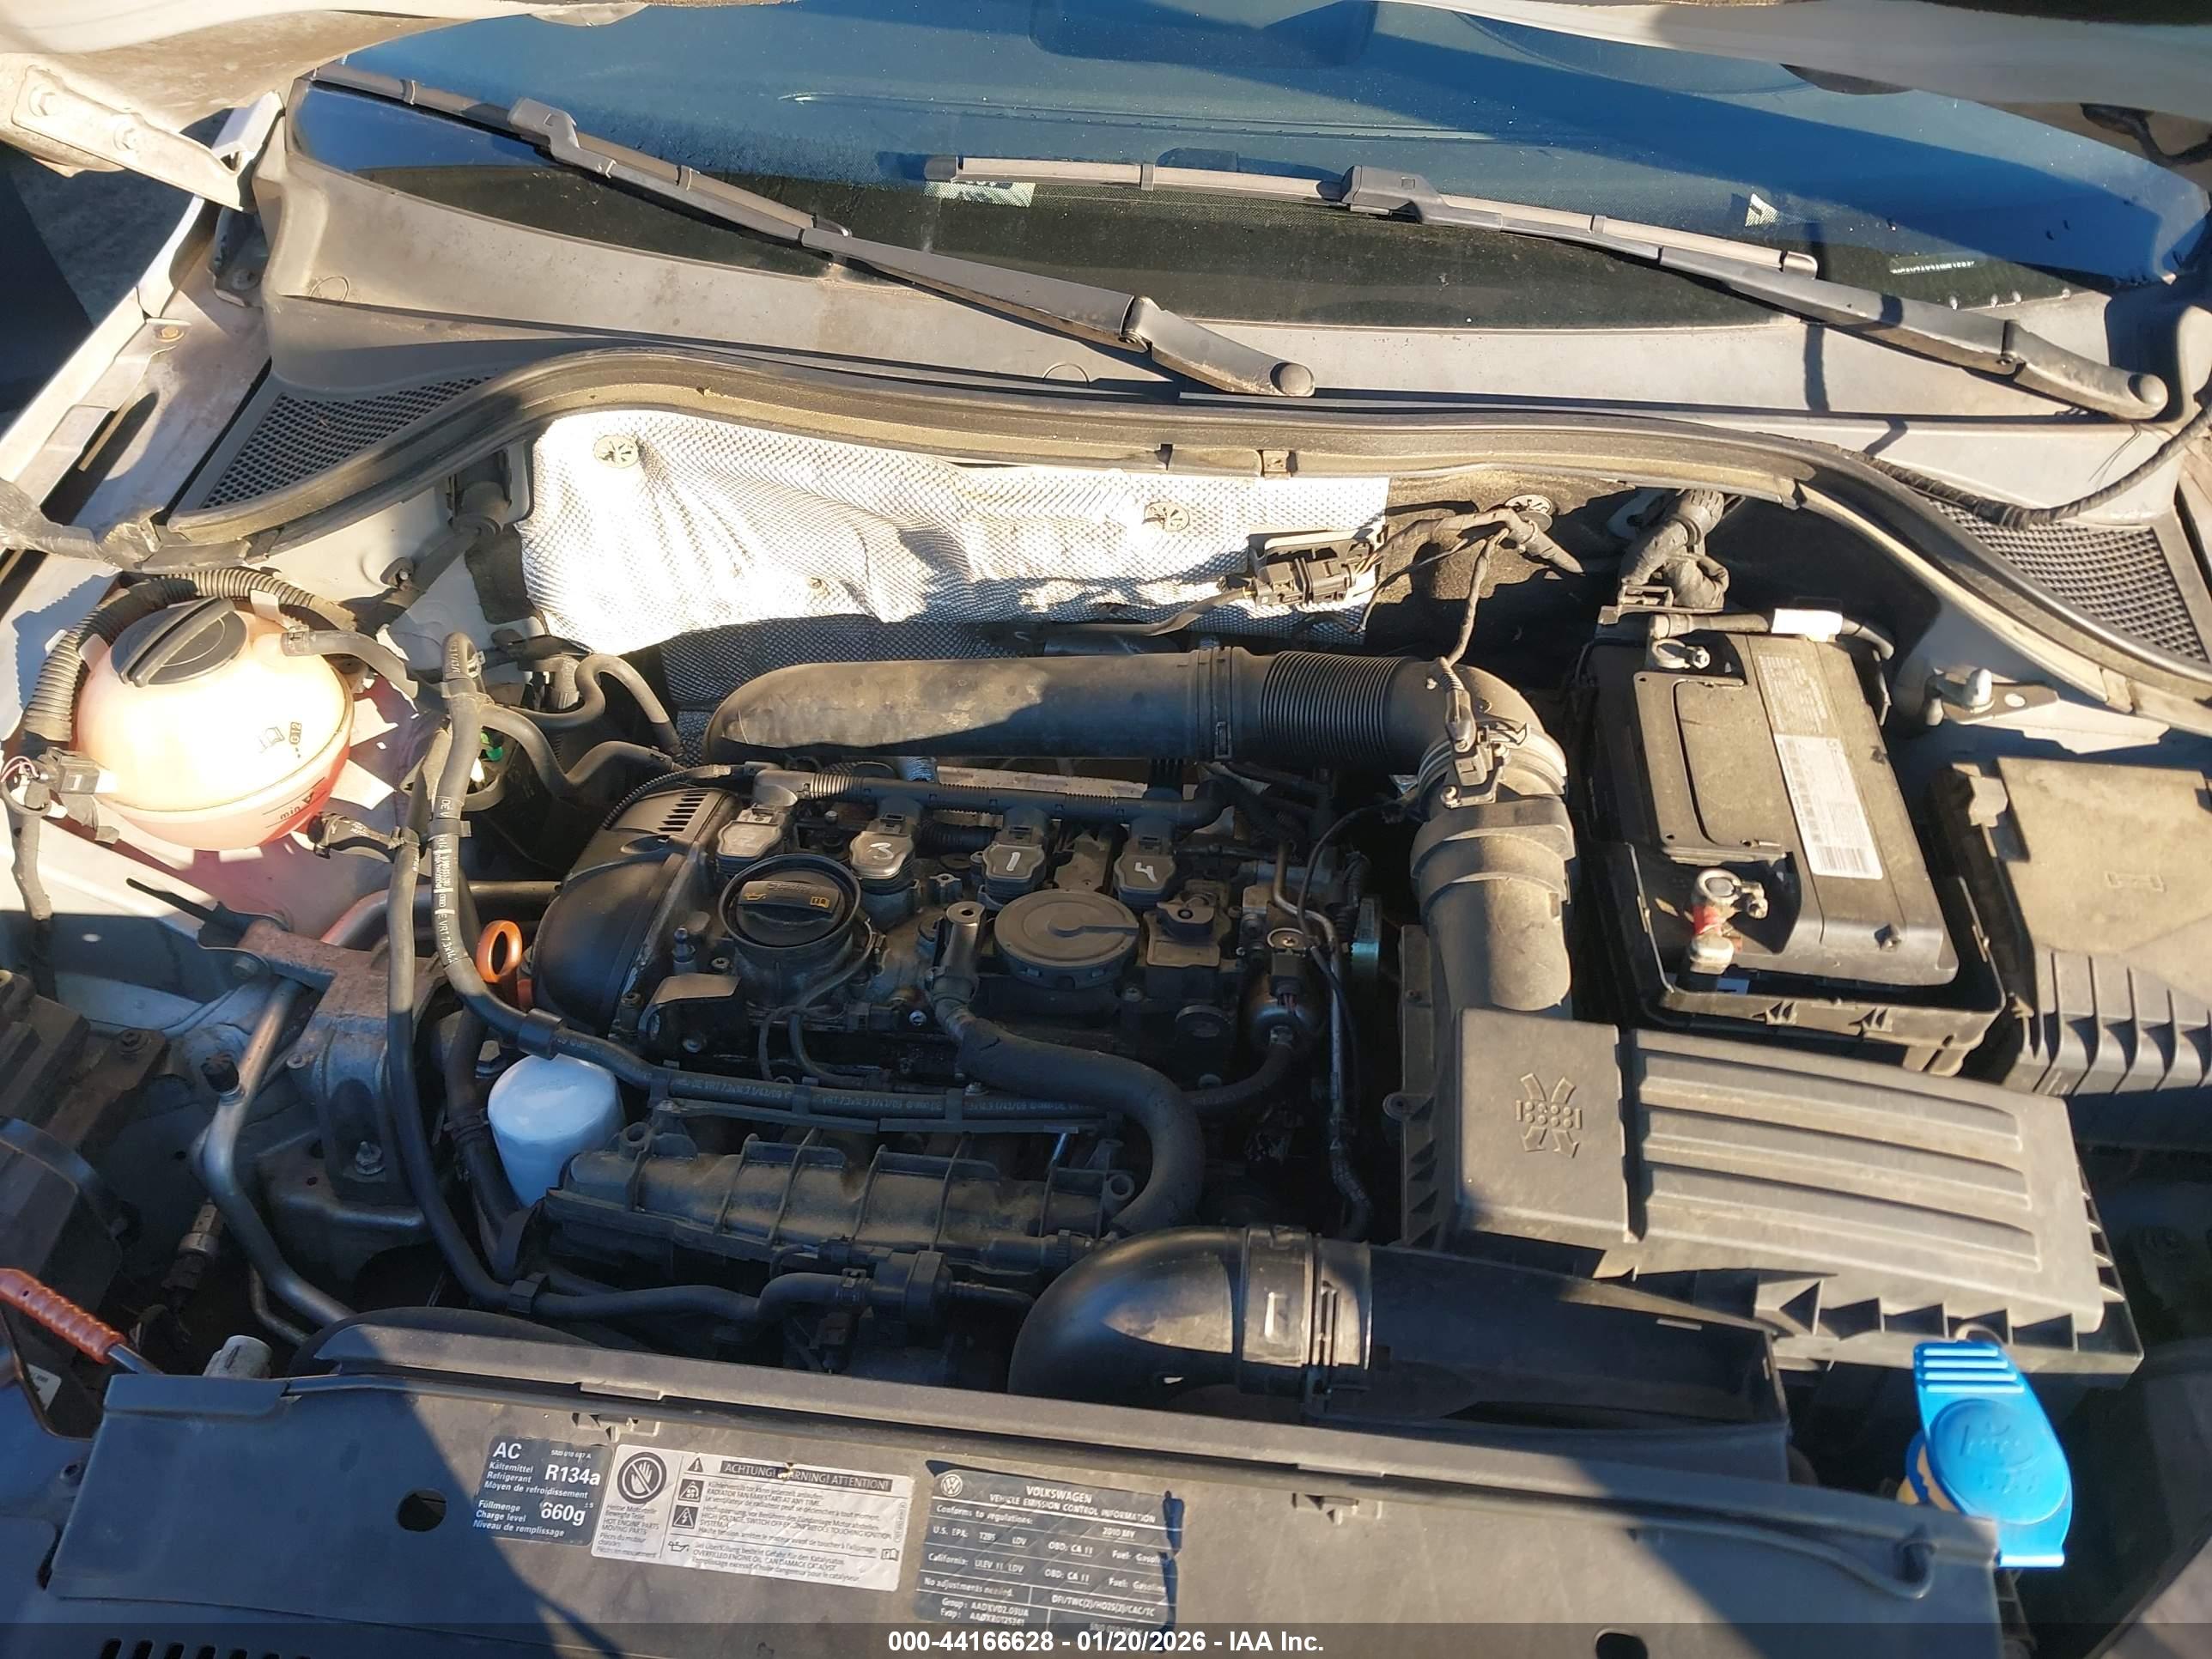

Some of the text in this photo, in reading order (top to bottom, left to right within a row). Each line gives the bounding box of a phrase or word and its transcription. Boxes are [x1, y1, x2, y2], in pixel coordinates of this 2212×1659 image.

[280, 806, 301, 820] min
[870, 842, 893, 860] 3
[1005, 852, 1021, 872] 1
[493, 1443, 522, 1460] AC
[489, 1460, 534, 1474] Kältemittel
[544, 1464, 601, 1486] R134a
[725, 1463, 776, 1477] ACHTUNG!
[487, 1472, 532, 1484] Refrigerant
[484, 1481, 511, 1491] Moyen
[526, 1486, 588, 1499] refroidissement
[1026, 1486, 1092, 1504] VOLKSWAGEN
[478, 1500, 520, 1512] Füllmenge
[936, 1504, 972, 1516] Conforms
[988, 1511, 1033, 1525] regulations:
[990, 1494, 1156, 1523] VEHICLE EMISSION CONTROL INFORMATION
[476, 1510, 526, 1522] Charge level
[473, 1520, 565, 1537] Niveau de remplissage
[933, 1527, 948, 1535] U.S.
[1070, 1544, 1082, 1553] CA
[928, 1553, 969, 1566] California:
[975, 1559, 993, 1570] ULEV
[1008, 1563, 1024, 1573] LDV
[1044, 1570, 1064, 1579] OBD:
[1066, 1572, 1079, 1582] CA
[924, 1577, 936, 1586] No
[937, 1578, 982, 1594] adjustments
